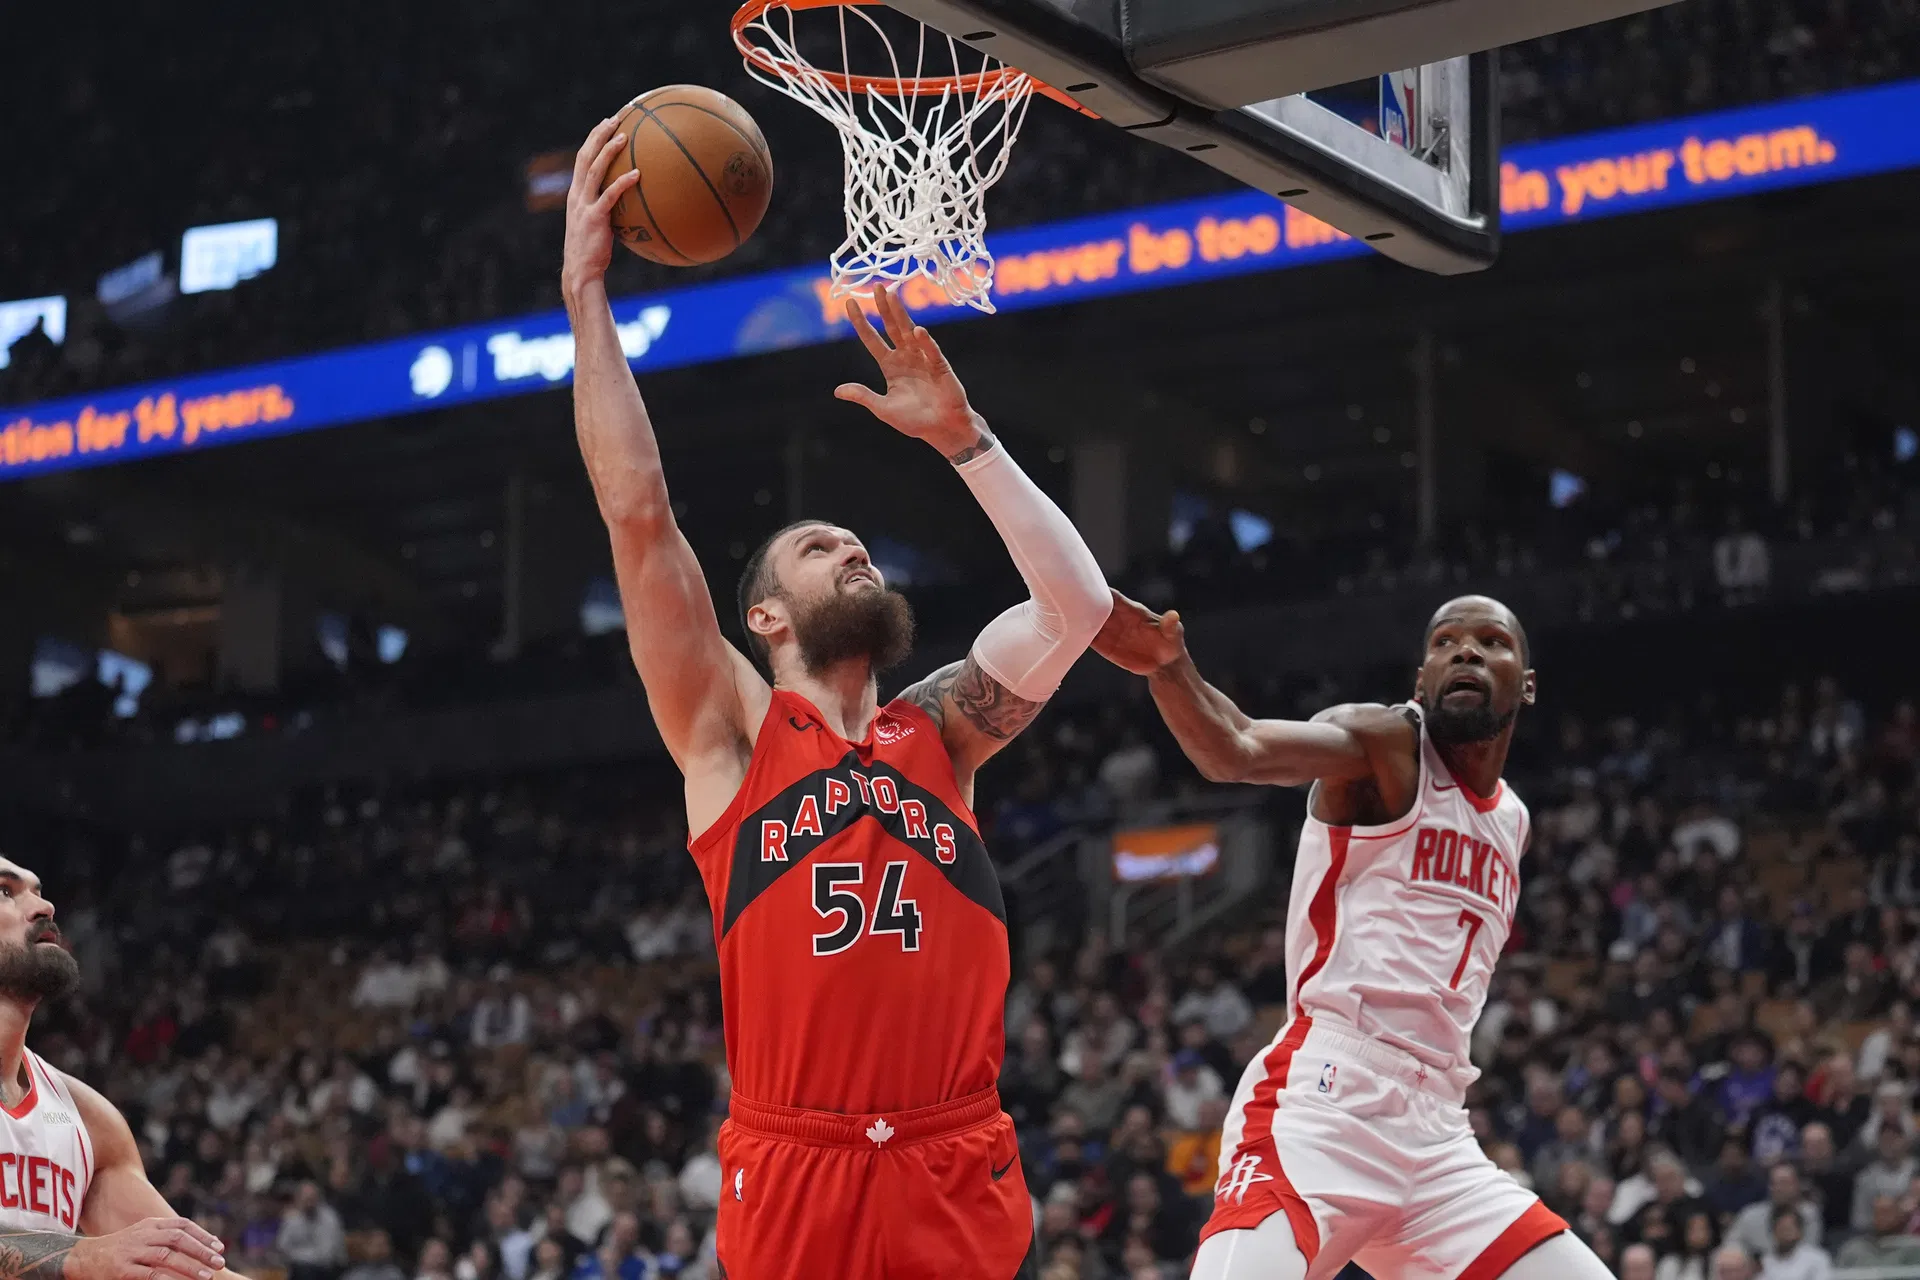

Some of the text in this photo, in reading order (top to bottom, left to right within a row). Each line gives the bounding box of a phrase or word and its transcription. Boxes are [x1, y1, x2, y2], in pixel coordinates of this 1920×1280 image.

[995, 240, 1124, 295] never
[1129, 223, 1191, 274] be
[1195, 213, 1280, 262] too
[1556, 149, 1675, 215] your
[1679, 123, 1836, 184] team.
[77, 405, 130, 453] for
[134, 392, 177, 443] 14
[181, 383, 293, 445] years.
[895, 727, 916, 740] Life
[761, 769, 956, 864] RAPTORS
[812, 860, 923, 956] 54
[1449, 908, 1484, 991] 7
